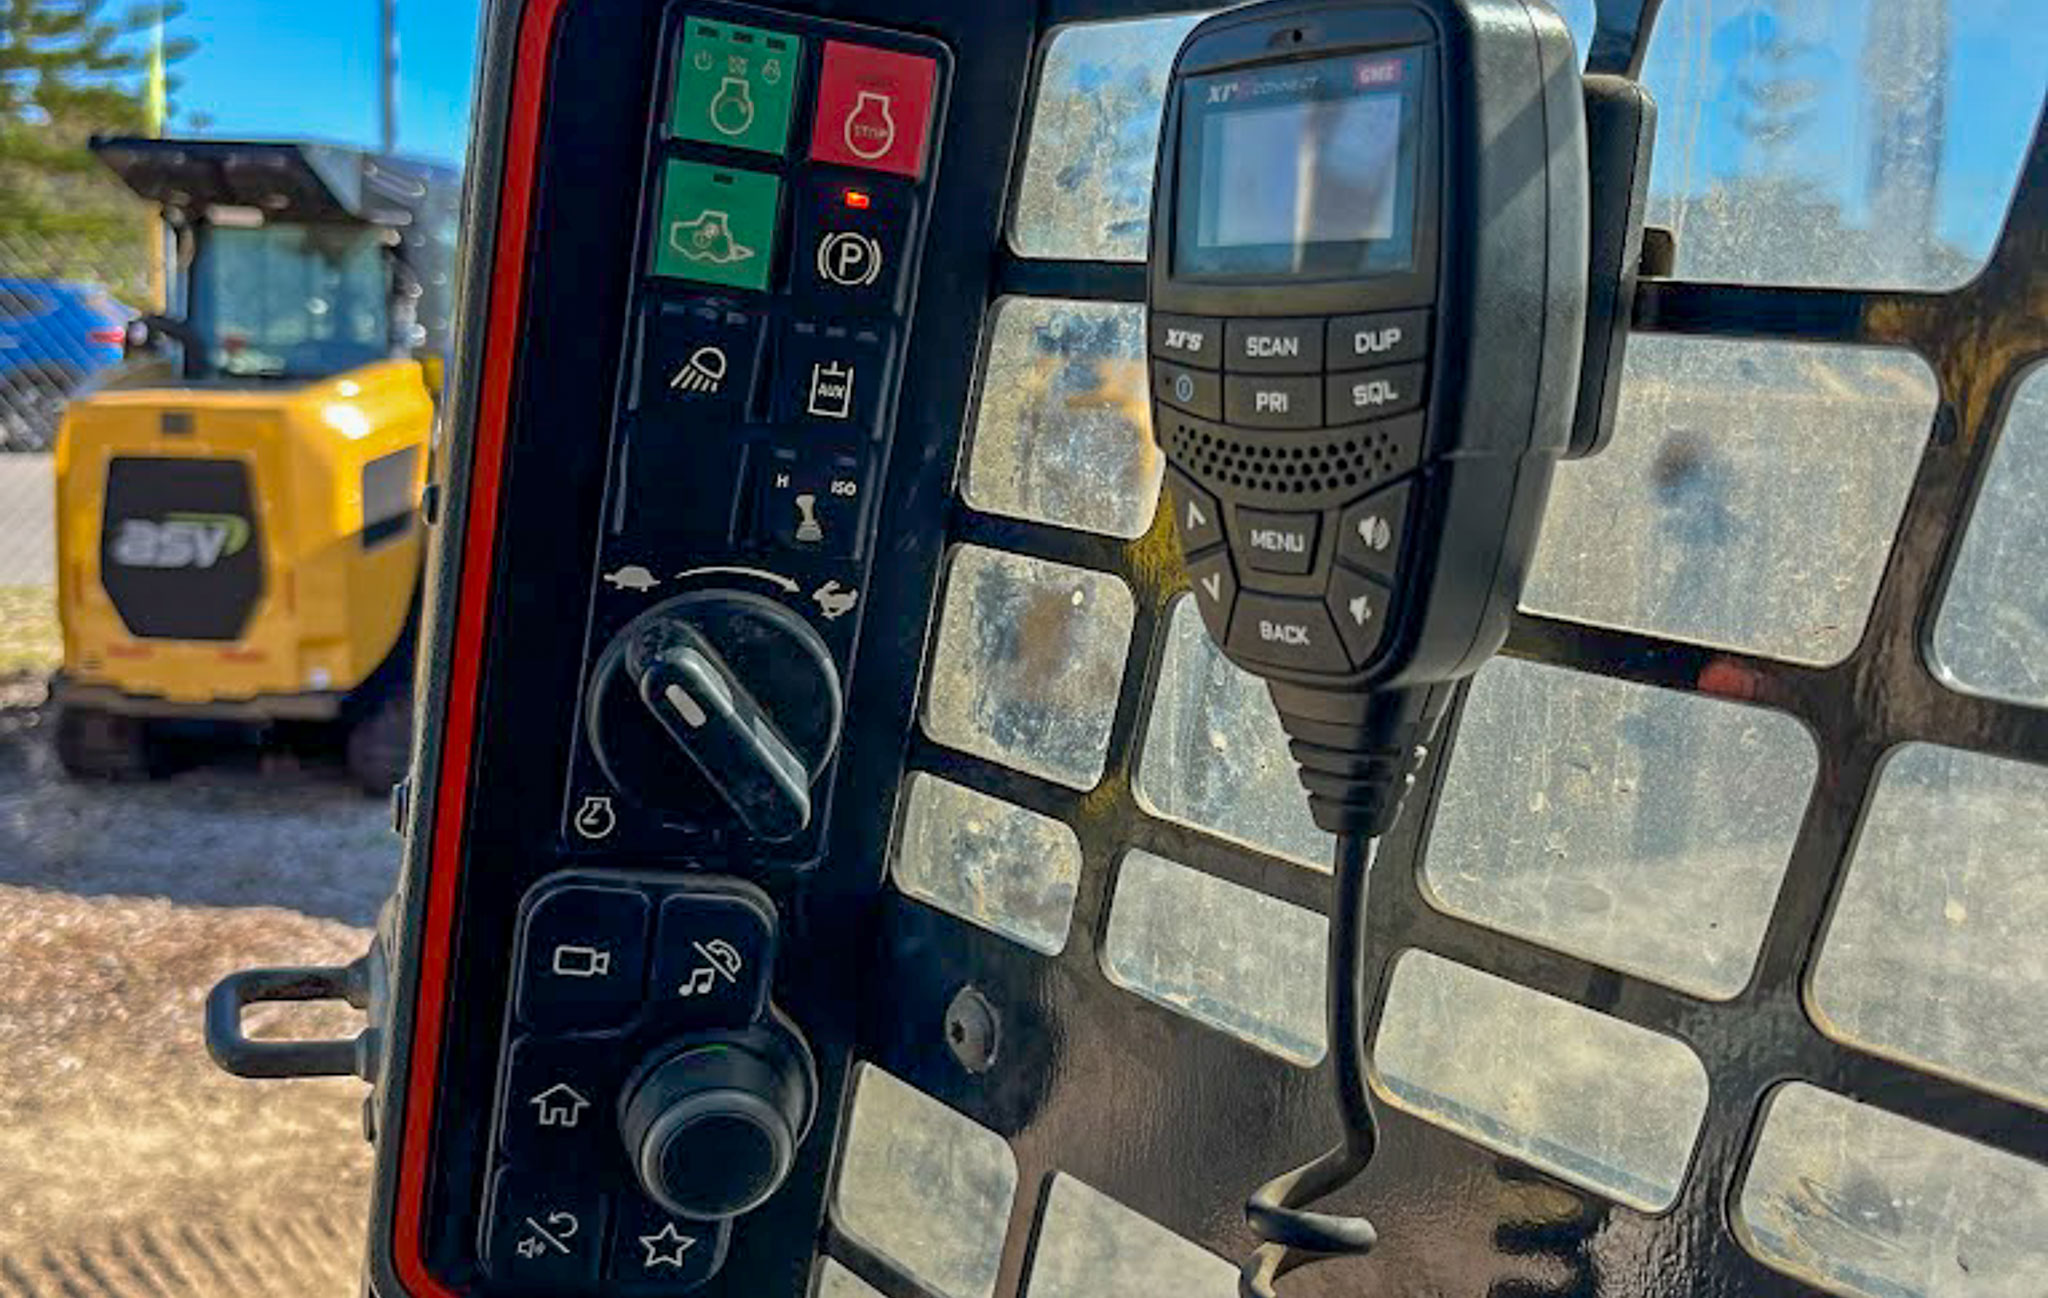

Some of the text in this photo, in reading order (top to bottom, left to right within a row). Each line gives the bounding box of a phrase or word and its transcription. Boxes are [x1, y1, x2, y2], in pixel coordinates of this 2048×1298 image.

[1246, 336, 1298, 357] SCAN
[1354, 328, 1401, 354] DUP
[817, 382, 846, 400] AUX
[1352, 380, 1398, 406] SQL
[1255, 392, 1288, 413] PRI
[776, 473, 790, 488] H
[831, 480, 857, 497] ISO
[1250, 529, 1304, 552] MENU
[1259, 620, 1311, 646] BACK
